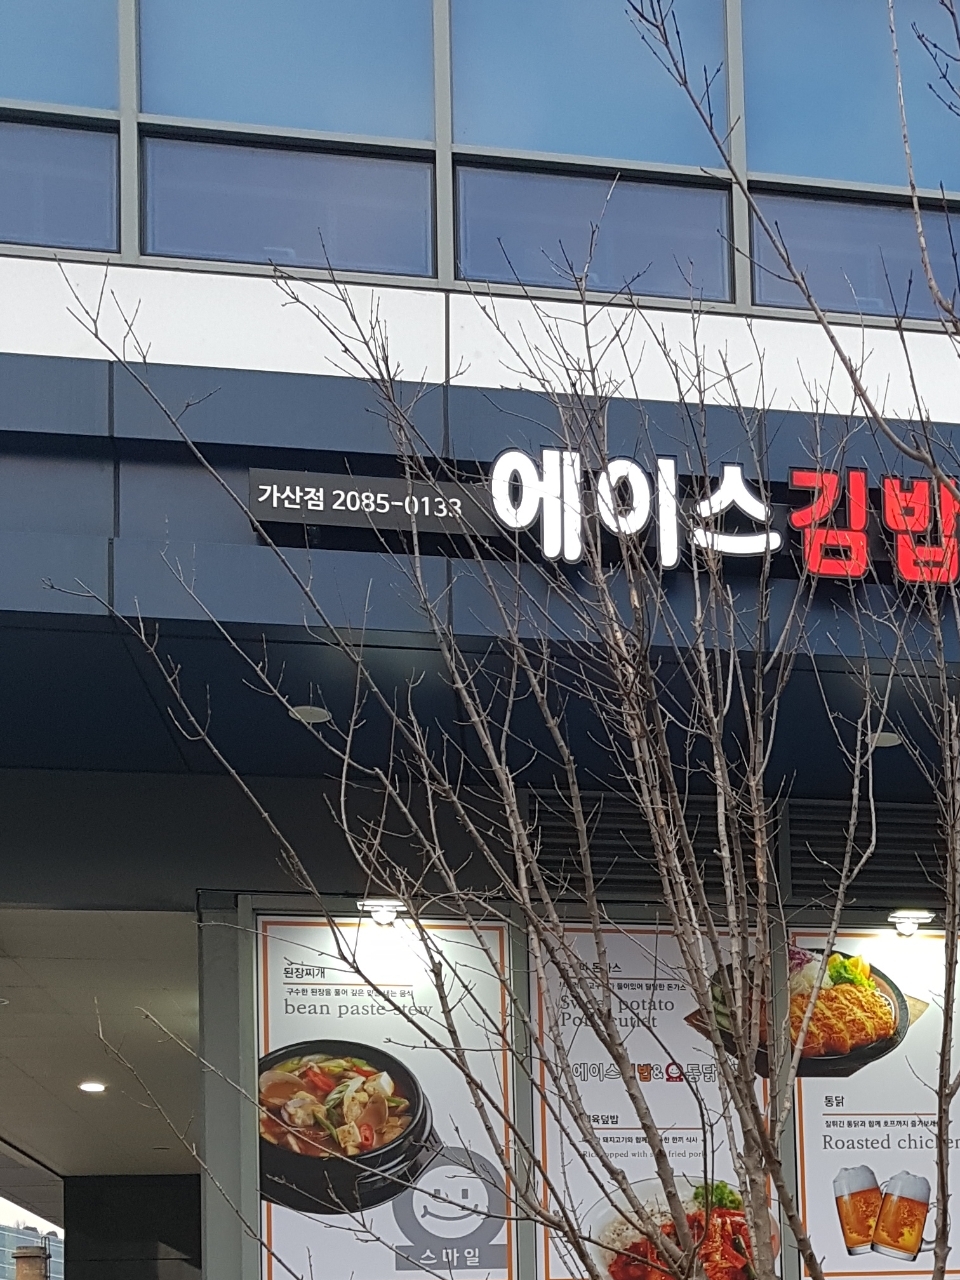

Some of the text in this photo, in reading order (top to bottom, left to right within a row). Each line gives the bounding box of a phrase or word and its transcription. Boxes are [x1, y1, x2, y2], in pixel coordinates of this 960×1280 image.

[257, 483, 462, 518] 가산점 2085-0133
[282, 967, 326, 979] 된장찌개
[284, 998, 434, 1018] bean paste stew
[618, 998, 675, 1014] potato
[824, 1095, 845, 1108] 통닭
[822, 1133, 892, 1150] Roasted
[604, 1151, 629, 1160] opped
[419, 1247, 481, 1267] 스마일
